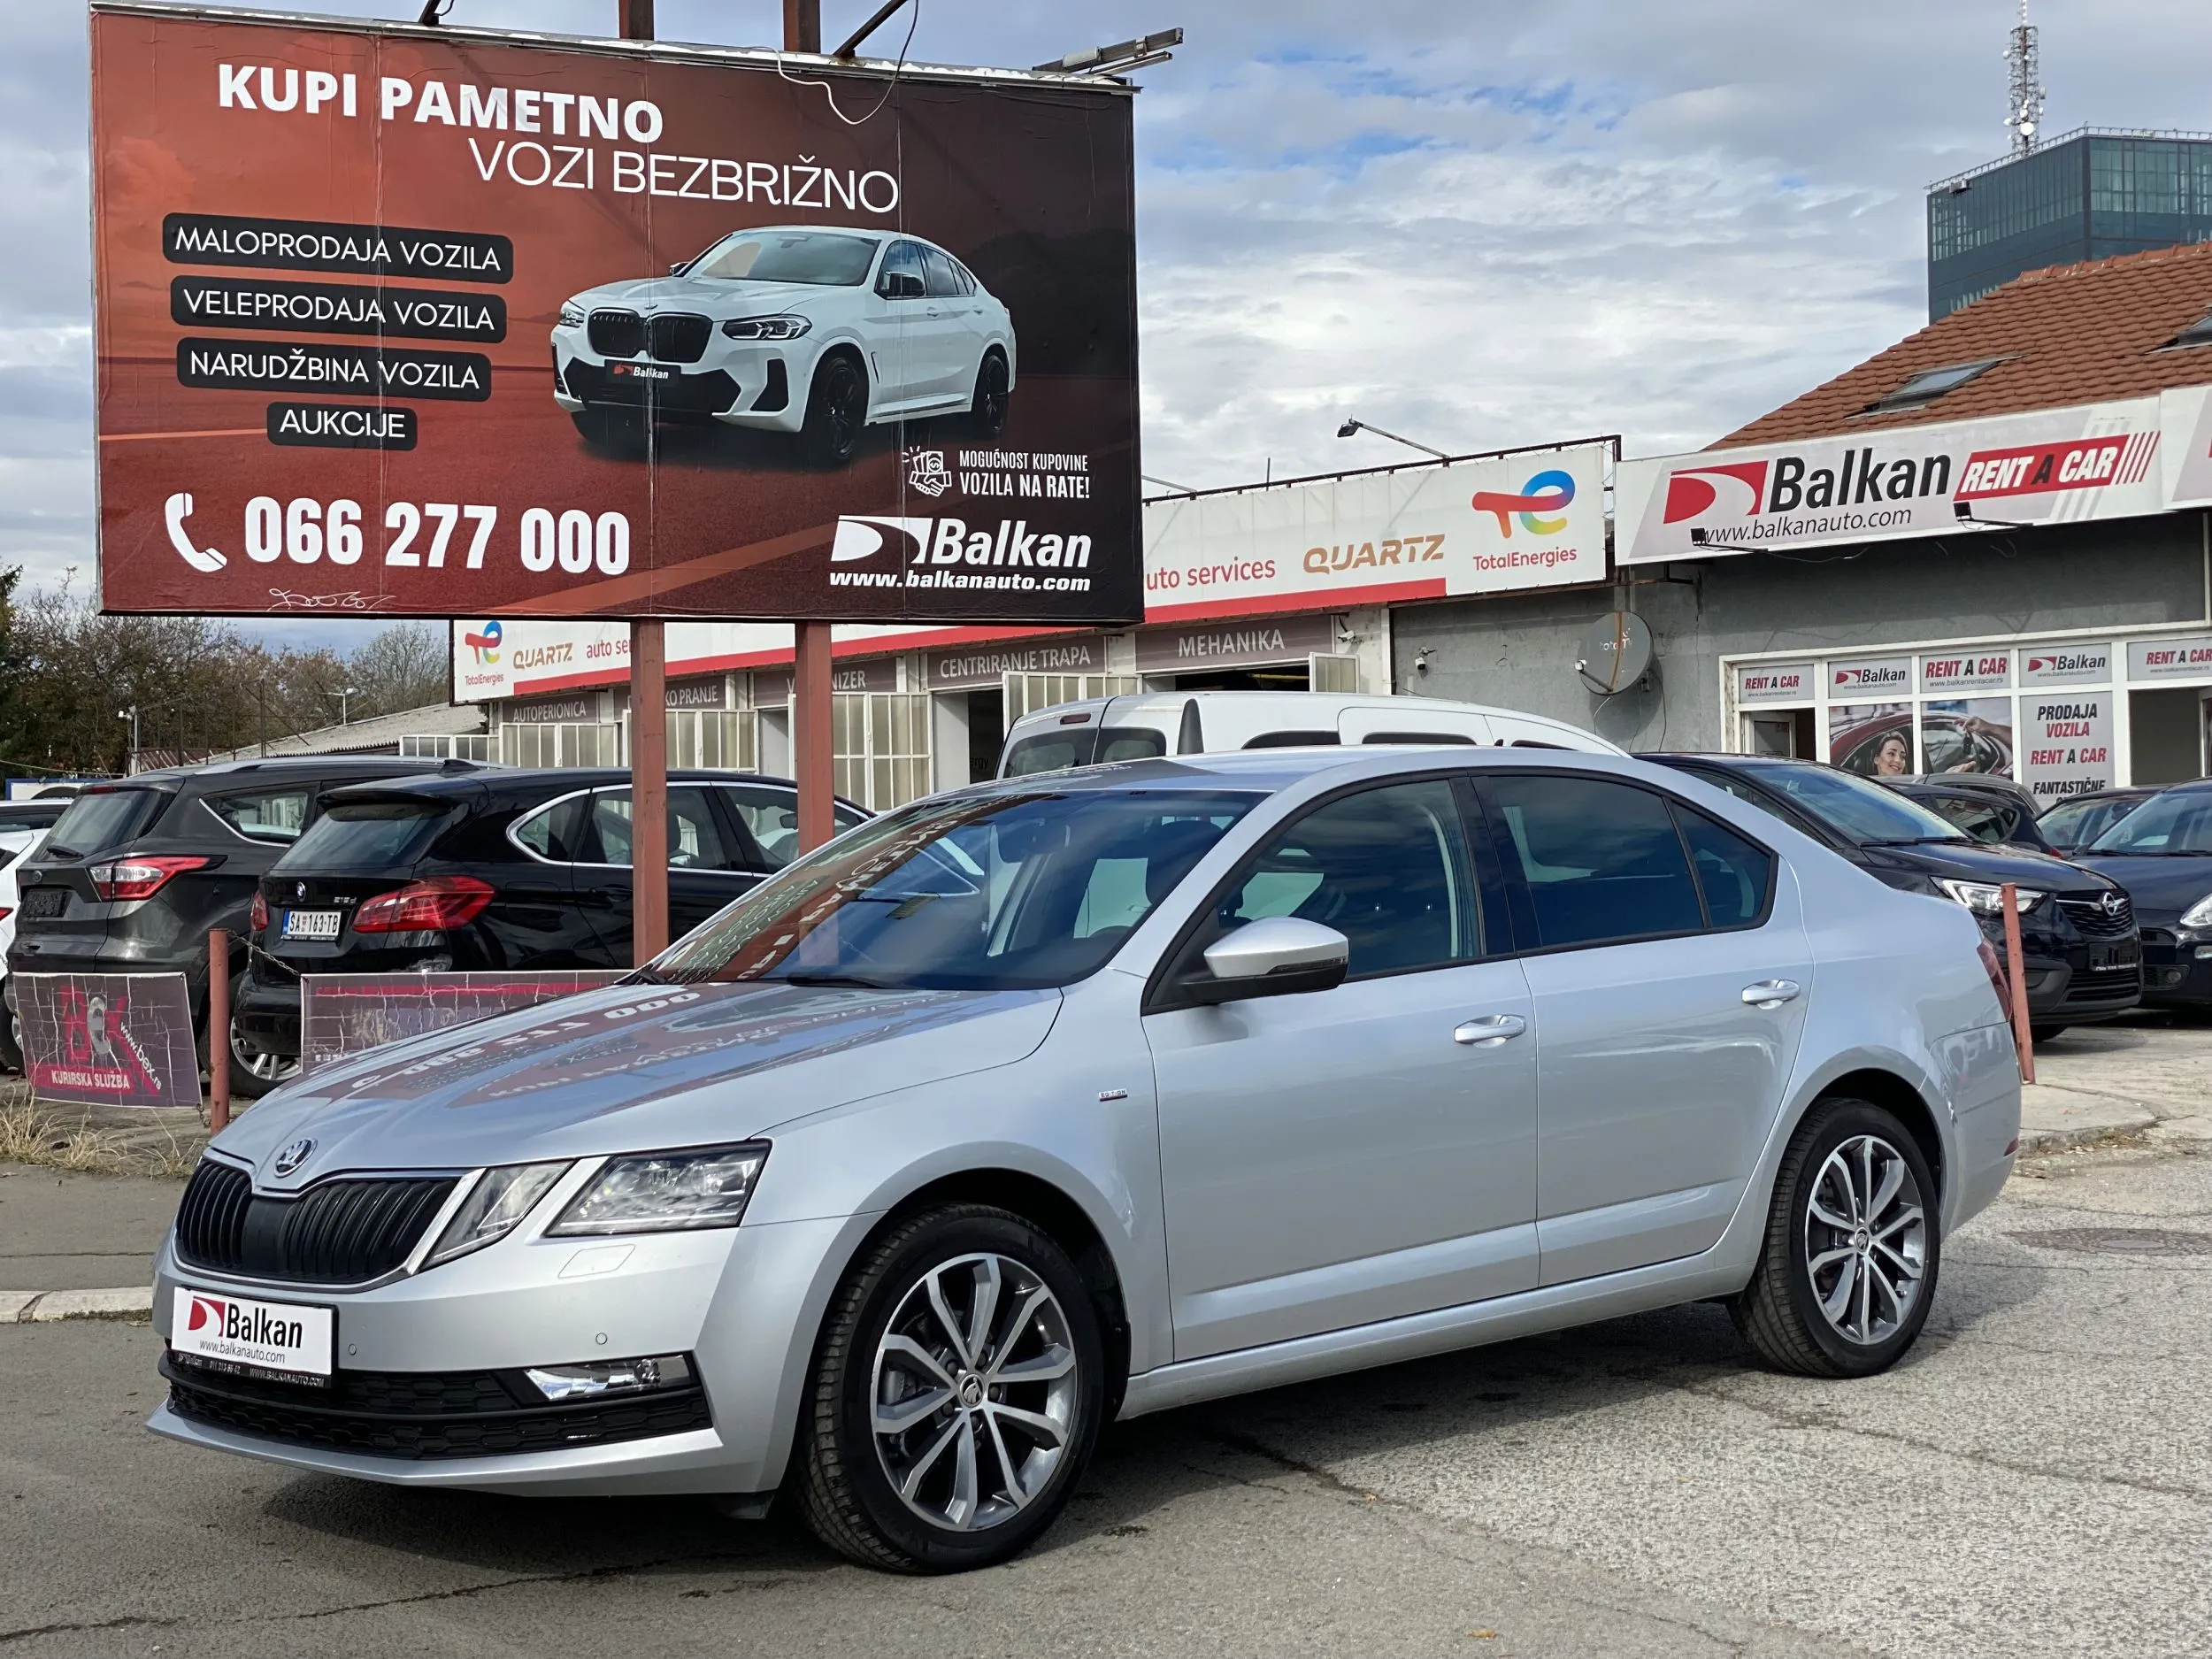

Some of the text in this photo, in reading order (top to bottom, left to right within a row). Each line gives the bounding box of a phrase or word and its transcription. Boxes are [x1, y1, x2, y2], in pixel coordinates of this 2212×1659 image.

[219, 63, 664, 143] KUPI PAMETNO
[468, 138, 899, 213] VOZI BEZBRIŽNO
[174, 227, 501, 271] MALOPRODAJA VOZILA
[183, 288, 495, 331] VELEPRODAJA VOZILA
[190, 347, 480, 390] NARUDŽBINA VOZILA
[280, 410, 406, 439] AUKCIJE
[959, 449, 1088, 472] MOGUĆNOST KUPOVINE
[959, 472, 1090, 499] VOZILA NA RATE!
[1769, 445, 2118, 514] Balkan RENT A CAR
[244, 495, 630, 575] 066 277 000
[932, 517, 1092, 568] Balkan
[1146, 534, 1446, 590] uto services QUARTZ
[1473, 546, 1578, 572] TotalEnergies
[829, 570, 1091, 592] www.balkanauto.com
[513, 642, 573, 670] QUARTZ
[587, 639, 612, 658] auto
[1179, 628, 1286, 658] MEHANIKA
[940, 645, 1091, 679] CENTRIRANJE TRAPA
[1925, 657, 2008, 679] RENT A CAR
[2057, 654, 2106, 670] Balkan
[2146, 650, 2176, 665] RENT
[2177, 649, 2186, 664] A
[465, 672, 503, 687] TotalEnergies
[1745, 675, 1800, 690] RENT A CAR
[1862, 667, 1906, 684] Balkan
[680, 685, 718, 706] PRANJE
[513, 701, 587, 723] AUTOPERIONICA
[2037, 703, 2099, 721] PRODAJA
[2046, 721, 2091, 738] VOZILA
[2030, 748, 2108, 765] RENT A CAR
[51, 1070, 93, 1087] KURIRSKA
[226, 1302, 303, 1349] Balkan
[199, 1339, 286, 1364] www.balkanauto.com
